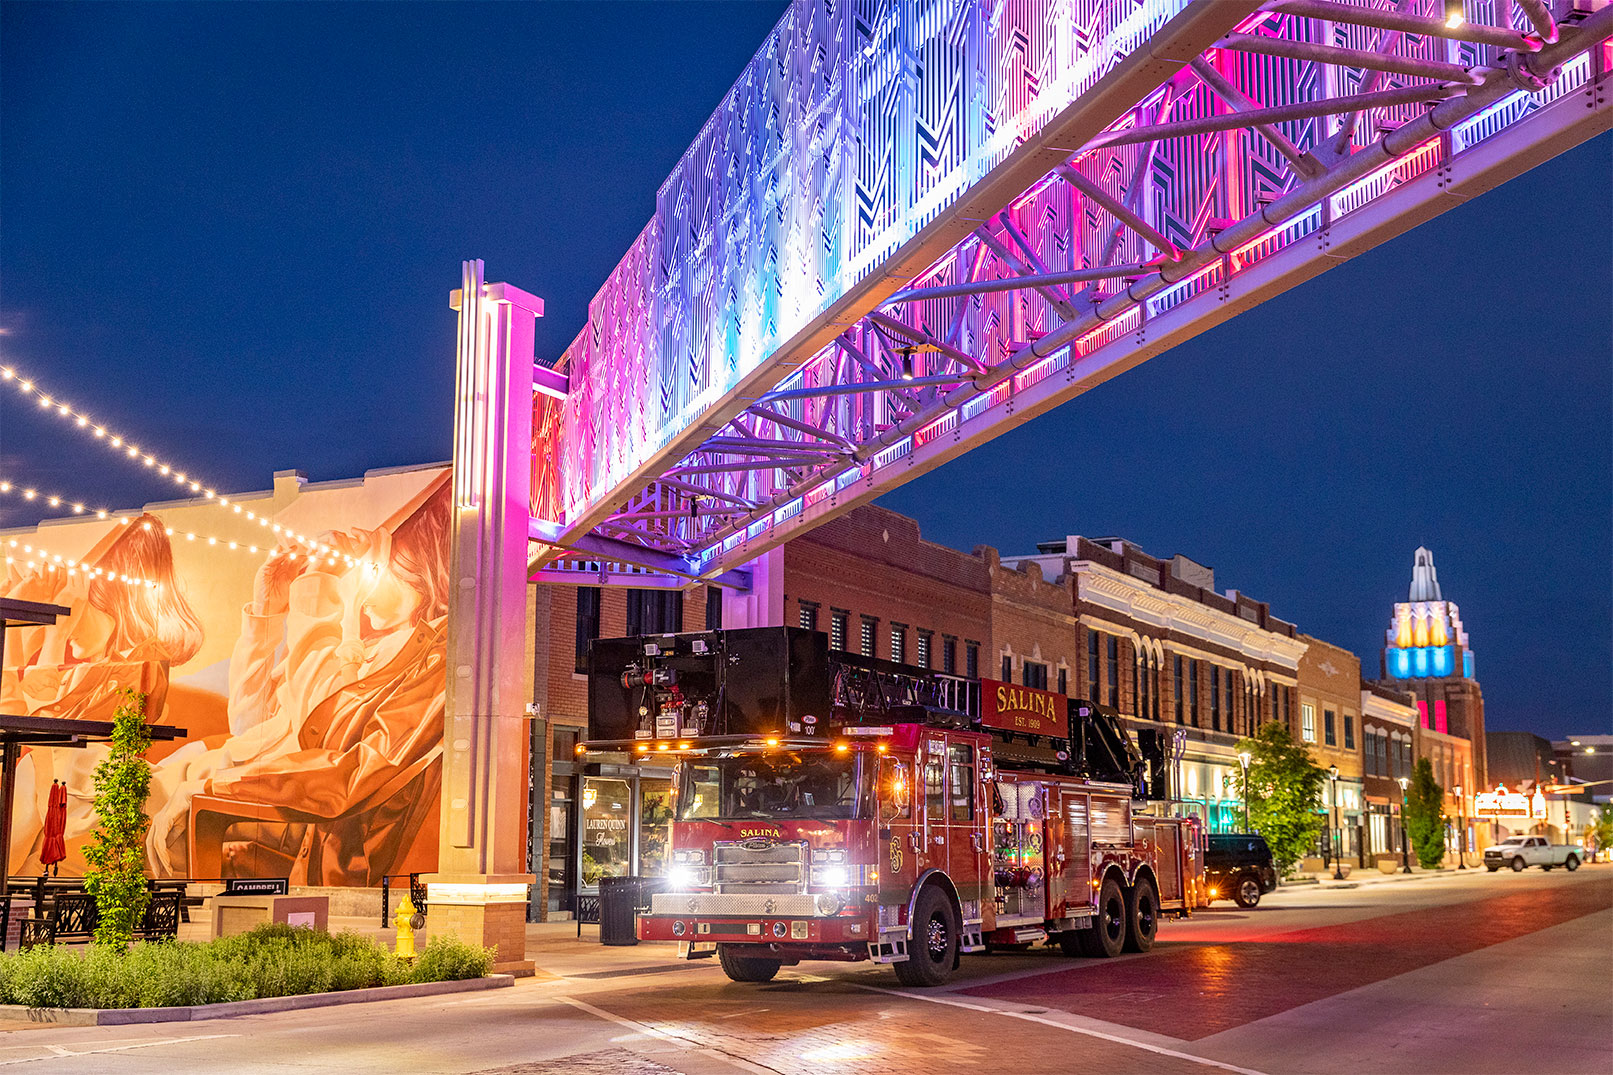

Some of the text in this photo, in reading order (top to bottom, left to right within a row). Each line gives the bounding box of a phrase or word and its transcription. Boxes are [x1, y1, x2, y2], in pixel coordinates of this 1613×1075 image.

[997, 686, 1057, 723] SALINA
[1015, 716, 1041, 729] EST. 1909
[586, 819, 626, 831] LAUREN QUINN
[740, 828, 781, 838] SALINA
